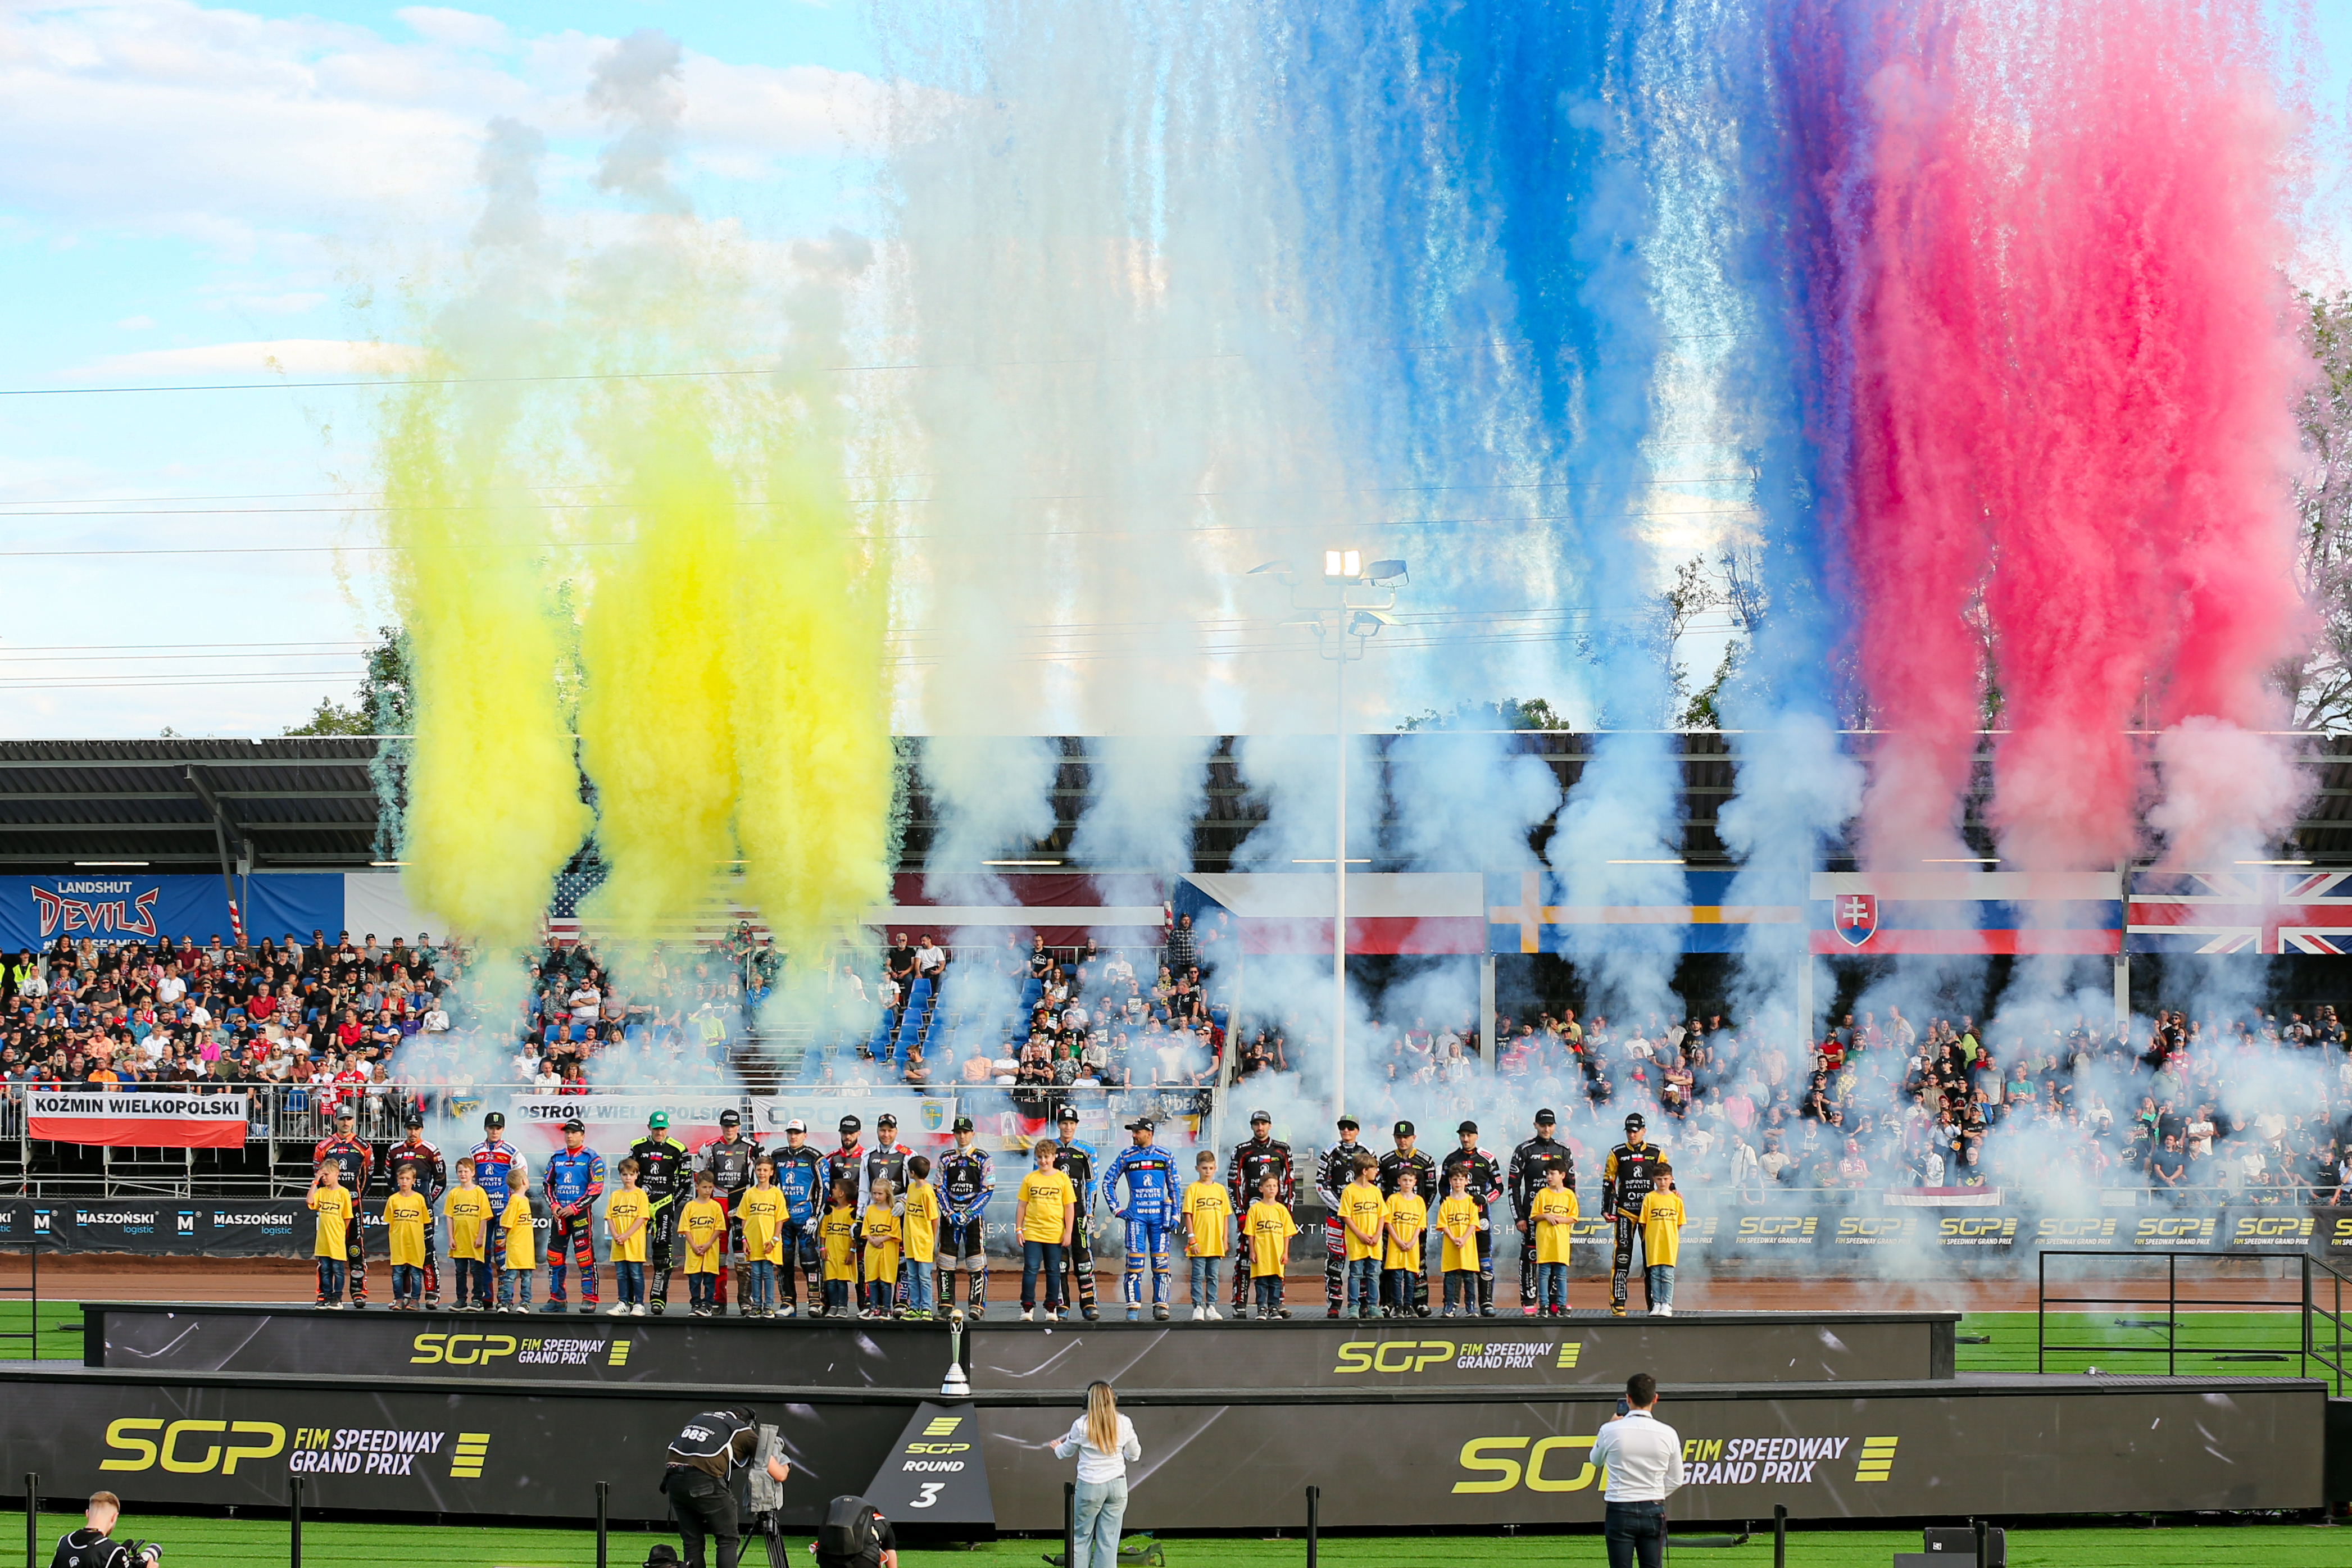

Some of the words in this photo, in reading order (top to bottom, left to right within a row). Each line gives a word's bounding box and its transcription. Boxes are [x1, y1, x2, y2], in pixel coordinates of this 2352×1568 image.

[58, 881, 132, 893] LANDSHUT
[30, 885, 160, 938] DEVILS
[35, 1095, 103, 1113] KOŹMIN
[109, 1099, 239, 1115] WIELKOPOLSKI
[517, 1102, 592, 1119] OSTRÓW
[1030, 1187, 1060, 1197] SGP
[453, 1203, 480, 1214] SGP
[750, 1203, 777, 1213] SGP
[1196, 1197, 1223, 1207] SGP
[1354, 1201, 1378, 1212] SGP
[393, 1209, 420, 1219] SGP
[1393, 1211, 1420, 1222] SGP
[1543, 1205, 1569, 1215] SGP
[1650, 1208, 1677, 1218] SGP
[76, 1211, 155, 1225] MASZOŃSKI
[213, 1212, 293, 1225] MASZOŃSKI
[689, 1216, 715, 1227] SGP
[1256, 1220, 1283, 1230] SGP
[1738, 1217, 1802, 1234] SGP
[123, 1225, 155, 1235] logistic
[261, 1226, 292, 1235] logistic
[869, 1224, 892, 1234] SGP
[1572, 1217, 1612, 1235] GP
[1837, 1217, 1902, 1235] SGP
[1938, 1217, 2003, 1235] SGP
[2037, 1218, 2101, 1235] SGP
[2136, 1218, 2200, 1235] SGP
[2236, 1217, 2300, 1235] SGP
[409, 1333, 517, 1365] SGP
[520, 1338, 542, 1351] FIM
[542, 1339, 606, 1353] SPEEDWAY
[1460, 1343, 1483, 1356] FIM
[1483, 1342, 1554, 1357] SPEEDWAY
[517, 1351, 559, 1365] GRAND
[560, 1352, 589, 1365] PRIX
[1333, 1340, 1455, 1373] SGP
[1456, 1355, 1503, 1369] GRAND
[1504, 1355, 1536, 1369] PRIX
[293, 1428, 331, 1449] FIM
[332, 1429, 446, 1454] SPEEDWAY
[680, 1428, 709, 1443] 085
[99, 1418, 286, 1475] SGP
[905, 1442, 971, 1455] SGP
[1683, 1439, 1723, 1461] FIM
[1724, 1437, 1850, 1461] SPEEDWAY
[289, 1450, 362, 1474] GRAND
[365, 1452, 415, 1476] PRIX
[902, 1460, 965, 1472] ROUND
[1451, 1435, 1607, 1494] SG
[1681, 1461, 1756, 1485] GRAND
[1760, 1460, 1817, 1484] PRIX
[909, 1481, 946, 1508] 3
